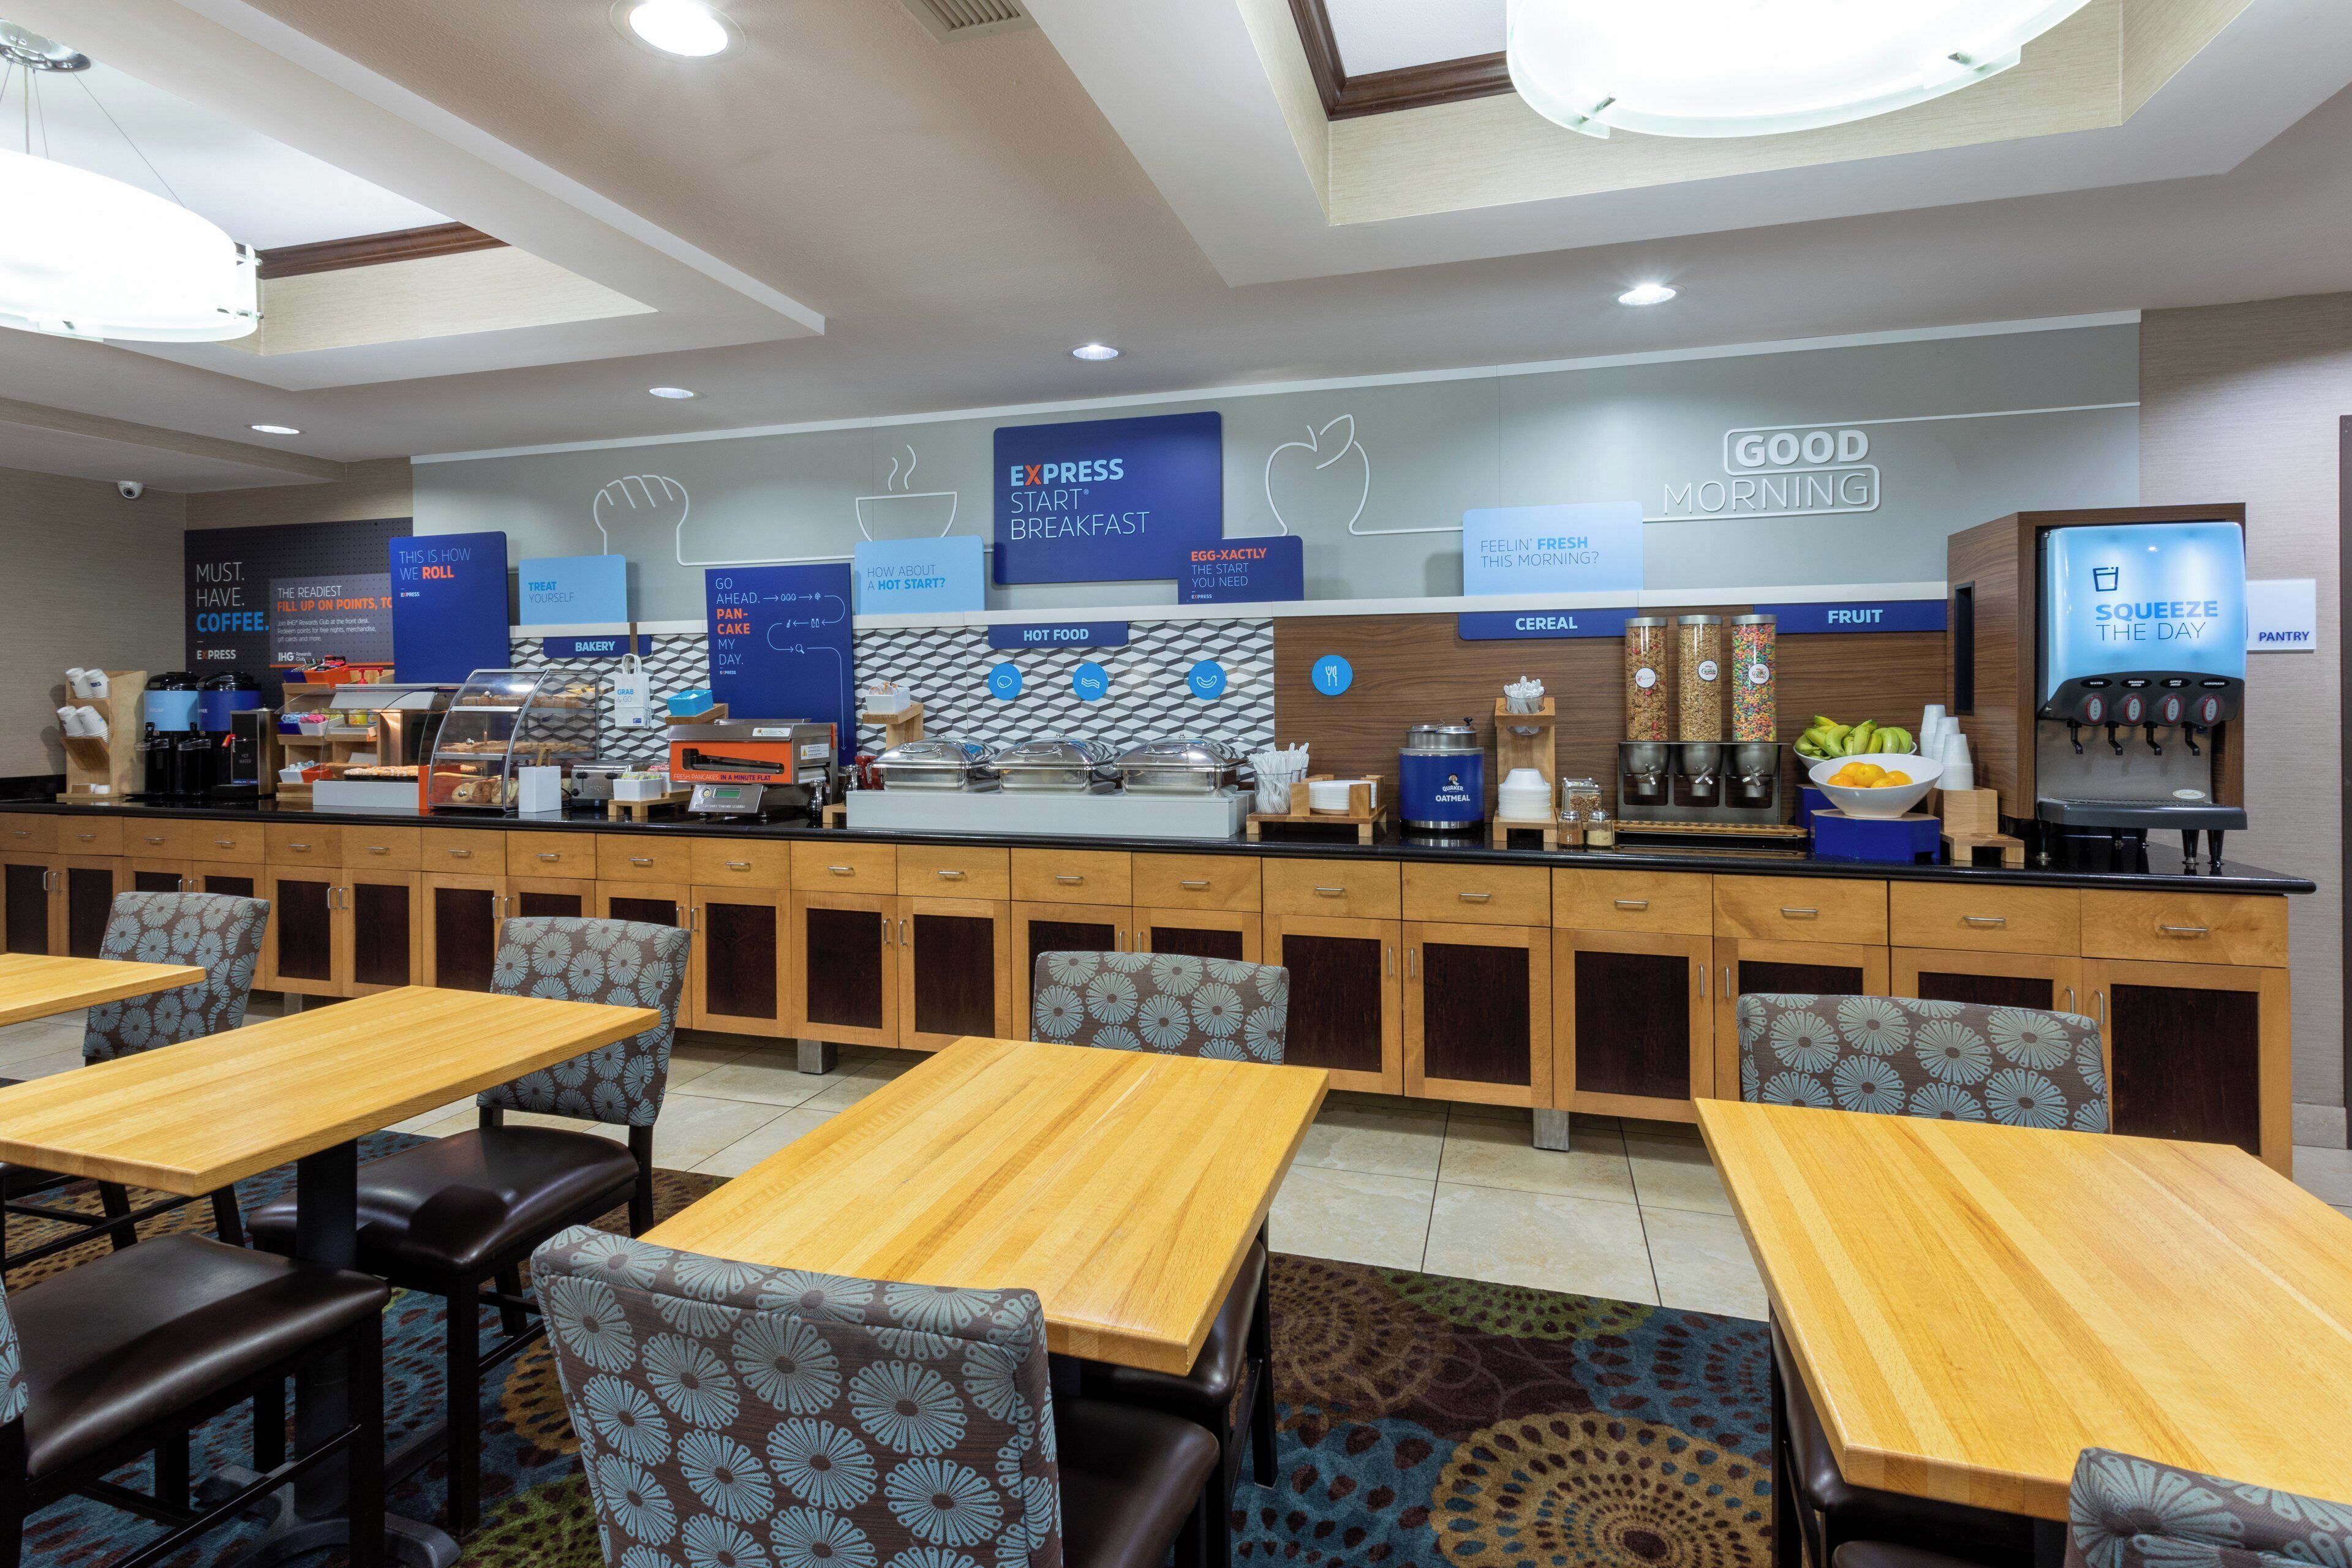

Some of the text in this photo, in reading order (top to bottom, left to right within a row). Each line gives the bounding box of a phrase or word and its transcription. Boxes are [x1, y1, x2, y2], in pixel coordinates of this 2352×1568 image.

[1735, 429, 1868, 467] GOOD
[1011, 458, 1125, 486] EXPRESS
[1665, 473, 1868, 514] MORNING
[1011, 511, 1150, 540] BREAKFAST
[1481, 537, 1588, 552] FEELIN' FRESH
[399, 548, 471, 564] THIS IS HOW
[1191, 548, 1267, 562] EGG-XACTLY
[1481, 551, 1599, 568] THIS MORNING?
[197, 562, 244, 582] MUST.
[400, 565, 454, 581] WE ROLL
[867, 564, 936, 578] HOW ABOUT
[1191, 562, 1249, 575] THE START
[528, 581, 557, 592] TREAT
[715, 578, 733, 589] GO
[867, 578, 946, 591] A HOT START?
[1192, 576, 1248, 588] YOU NEED
[197, 587, 244, 608] HAVE.
[277, 586, 342, 598] THE READIEST
[529, 592, 575, 603] YOURSELF
[716, 592, 760, 605] AHEAD.
[277, 601, 298, 612] FILL
[301, 600, 315, 611] UP
[318, 600, 333, 611] ON
[337, 598, 378, 611] POINTS,
[2095, 601, 2218, 622] SQUEEZE
[717, 608, 748, 619] PAN-
[1828, 609, 1883, 624] FRUIT
[197, 611, 270, 632] COFFEE.
[1515, 616, 1578, 630] CEREAL
[717, 623, 750, 635] CAKE
[1023, 628, 1089, 641] HOT FOOD
[2095, 622, 2206, 641] THE DAY
[2259, 631, 2310, 641] PANTRY
[575, 641, 616, 652] BAKERY
[718, 639, 736, 650] MY
[197, 649, 236, 660] EXPRESS
[719, 654, 744, 665] DAY.
